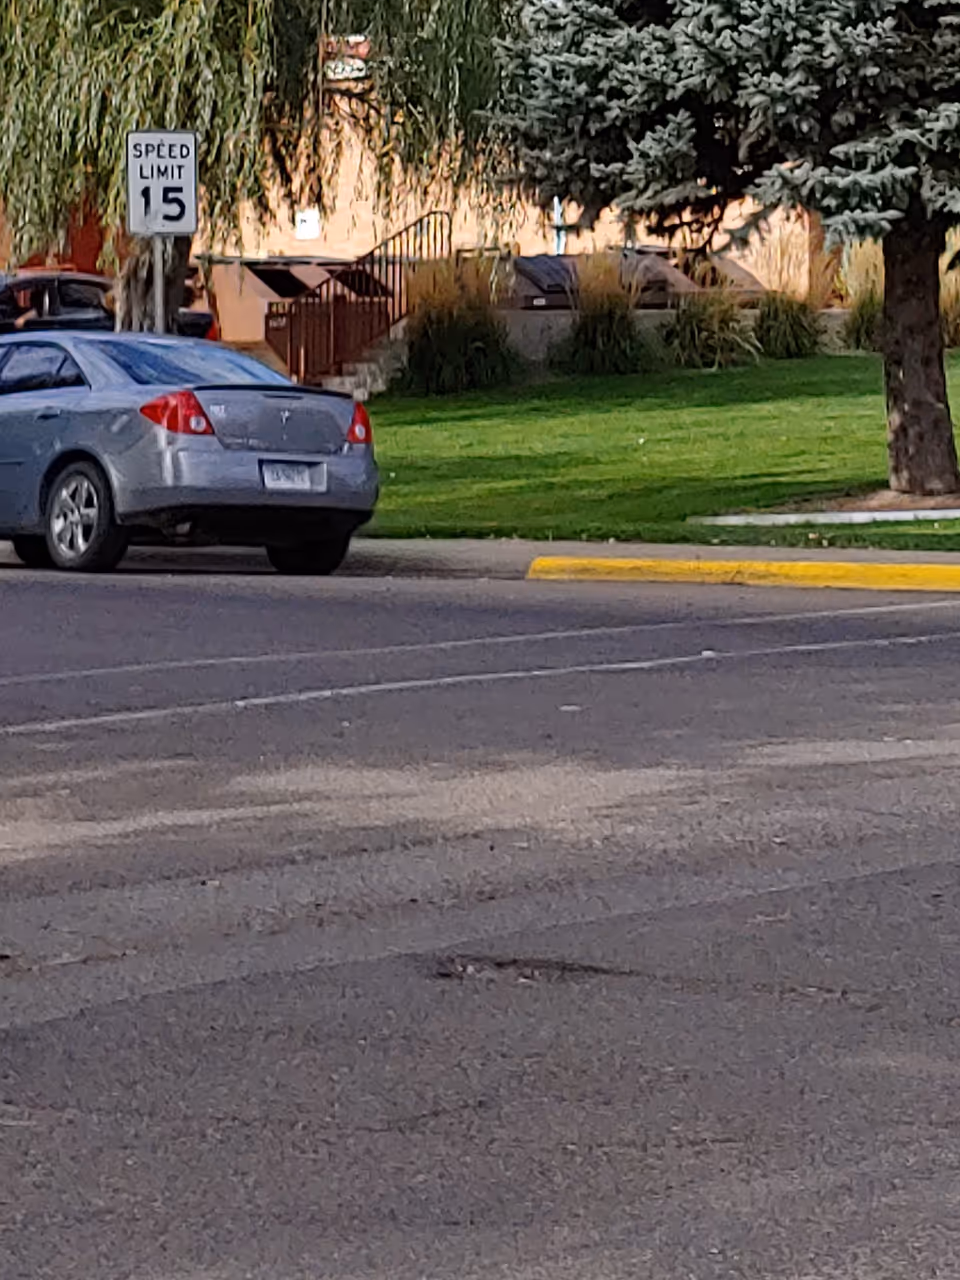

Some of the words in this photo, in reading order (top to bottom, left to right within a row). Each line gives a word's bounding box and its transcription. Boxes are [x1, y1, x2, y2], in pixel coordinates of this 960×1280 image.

[133, 143, 190, 159] SPEED
[139, 163, 185, 180] LIMIT
[141, 186, 186, 222] 15
